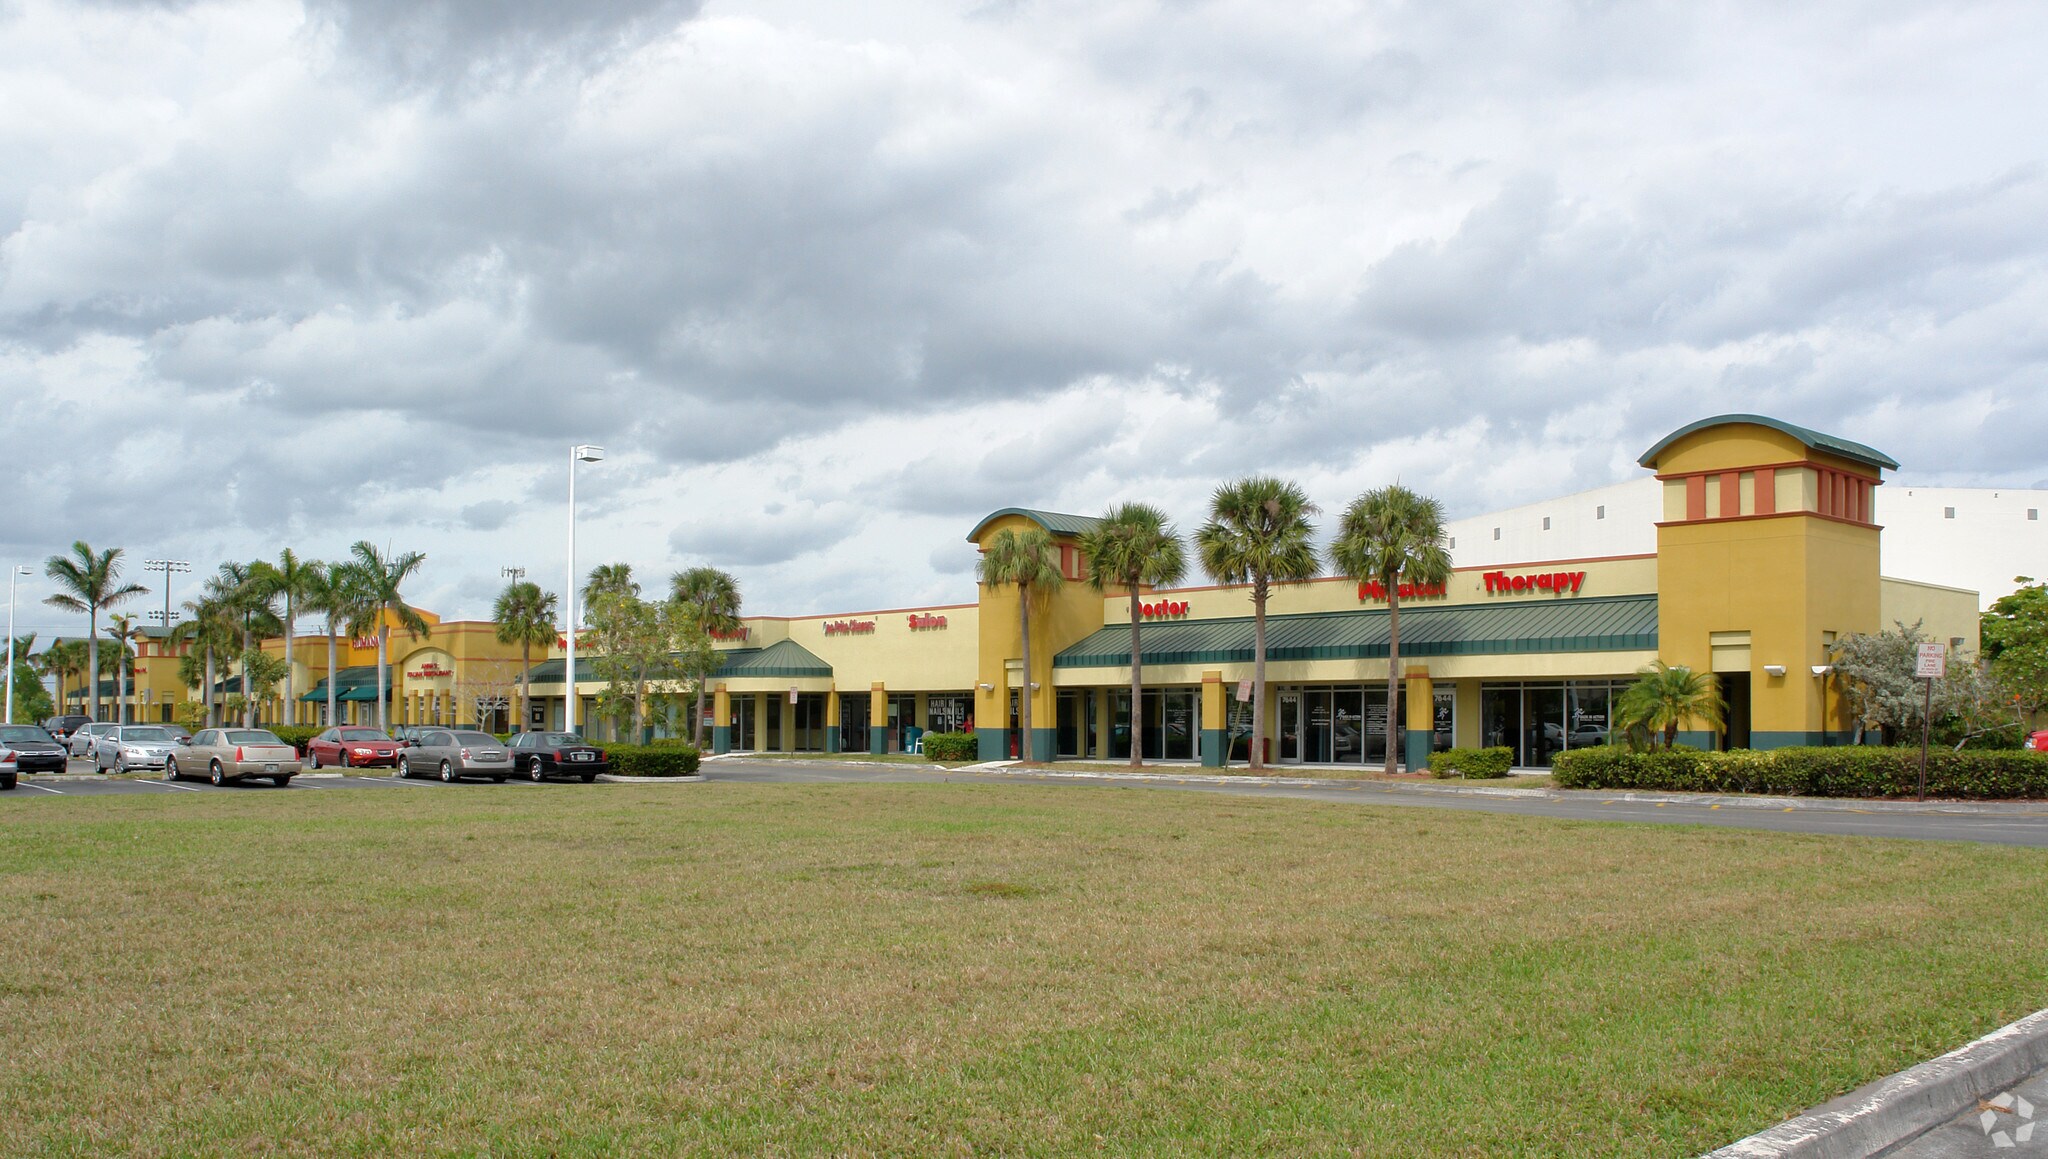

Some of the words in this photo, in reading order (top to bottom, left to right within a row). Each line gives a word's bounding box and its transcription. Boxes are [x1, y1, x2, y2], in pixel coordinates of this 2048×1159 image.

[1483, 571, 1585, 593] Therapy
[909, 613, 947, 629] Salon
[352, 635, 380, 648] HUMAN
[930, 699, 945, 707] HAIR
[929, 707, 946, 715] NAILS
